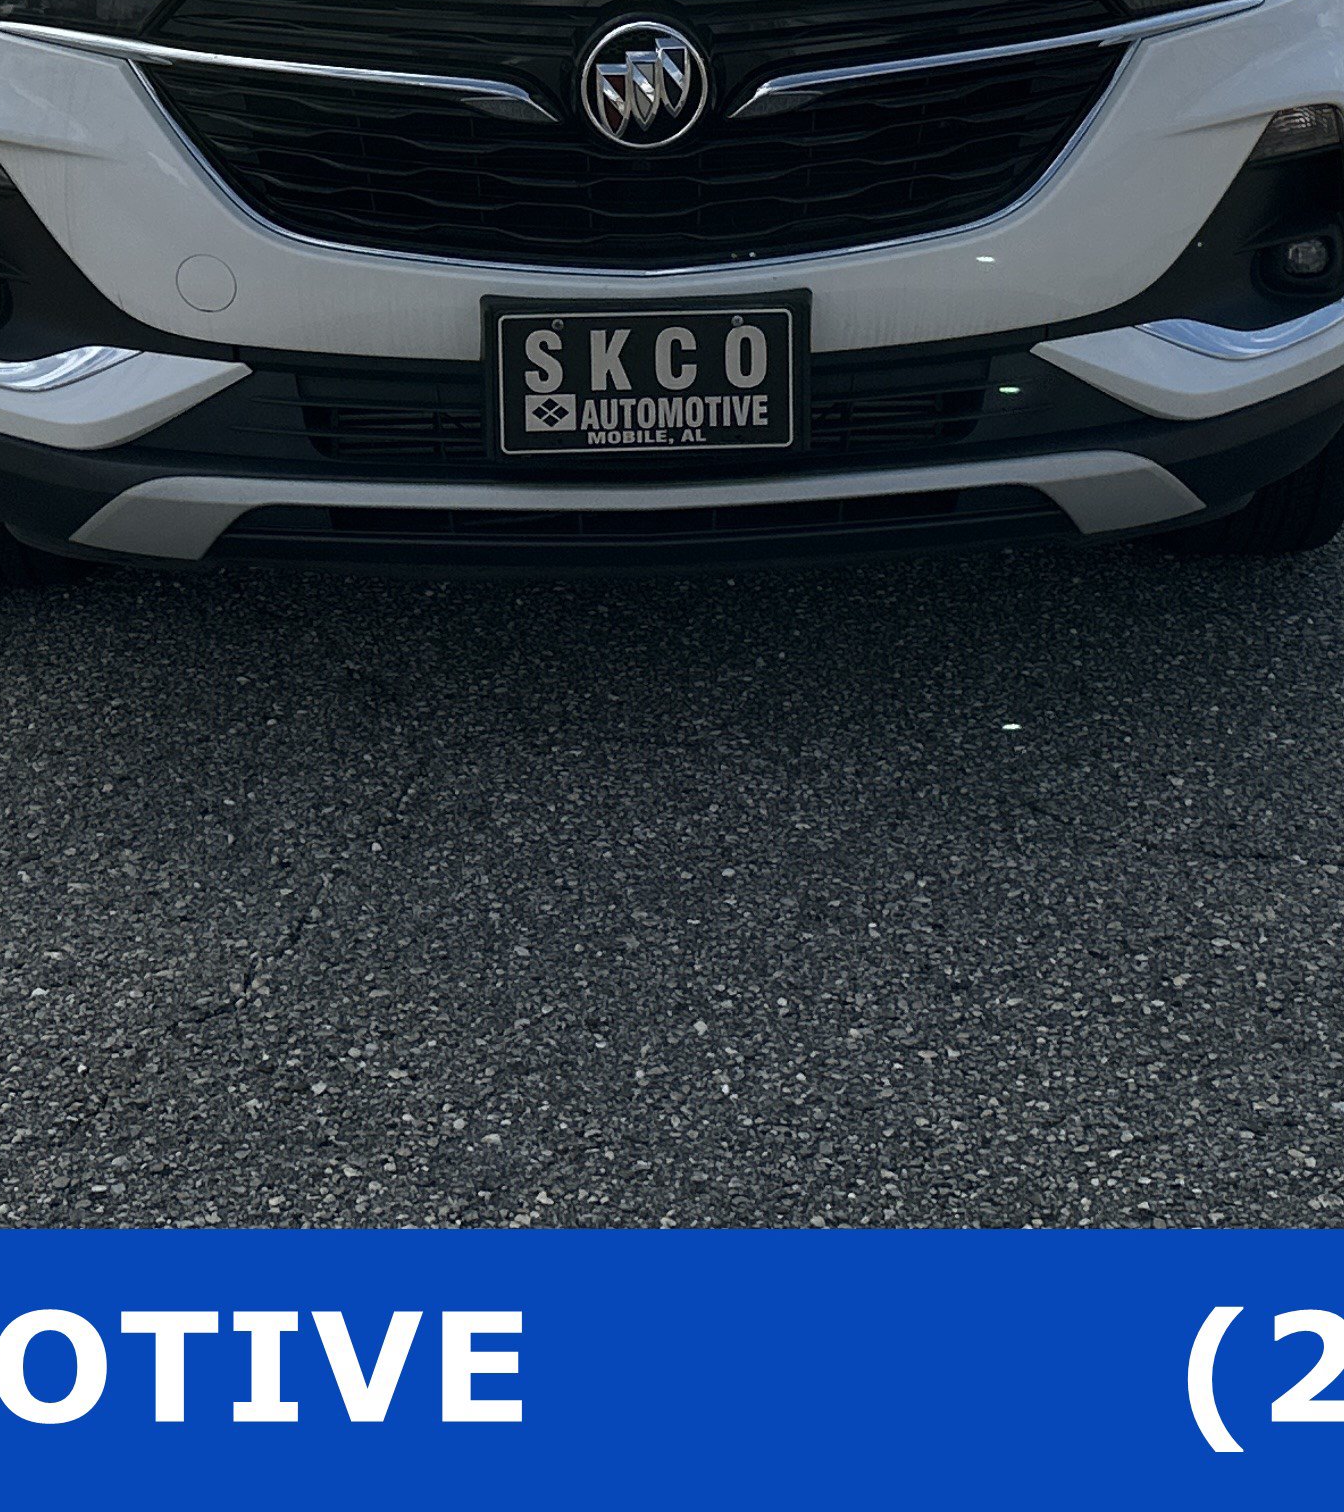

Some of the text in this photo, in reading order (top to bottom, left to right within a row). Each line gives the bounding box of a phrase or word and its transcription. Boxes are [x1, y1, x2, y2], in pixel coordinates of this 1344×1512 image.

[524, 324, 768, 394] SKCO
[580, 394, 769, 431] AUTOMOTIVE
[587, 428, 707, 445] MOBILE, AL
